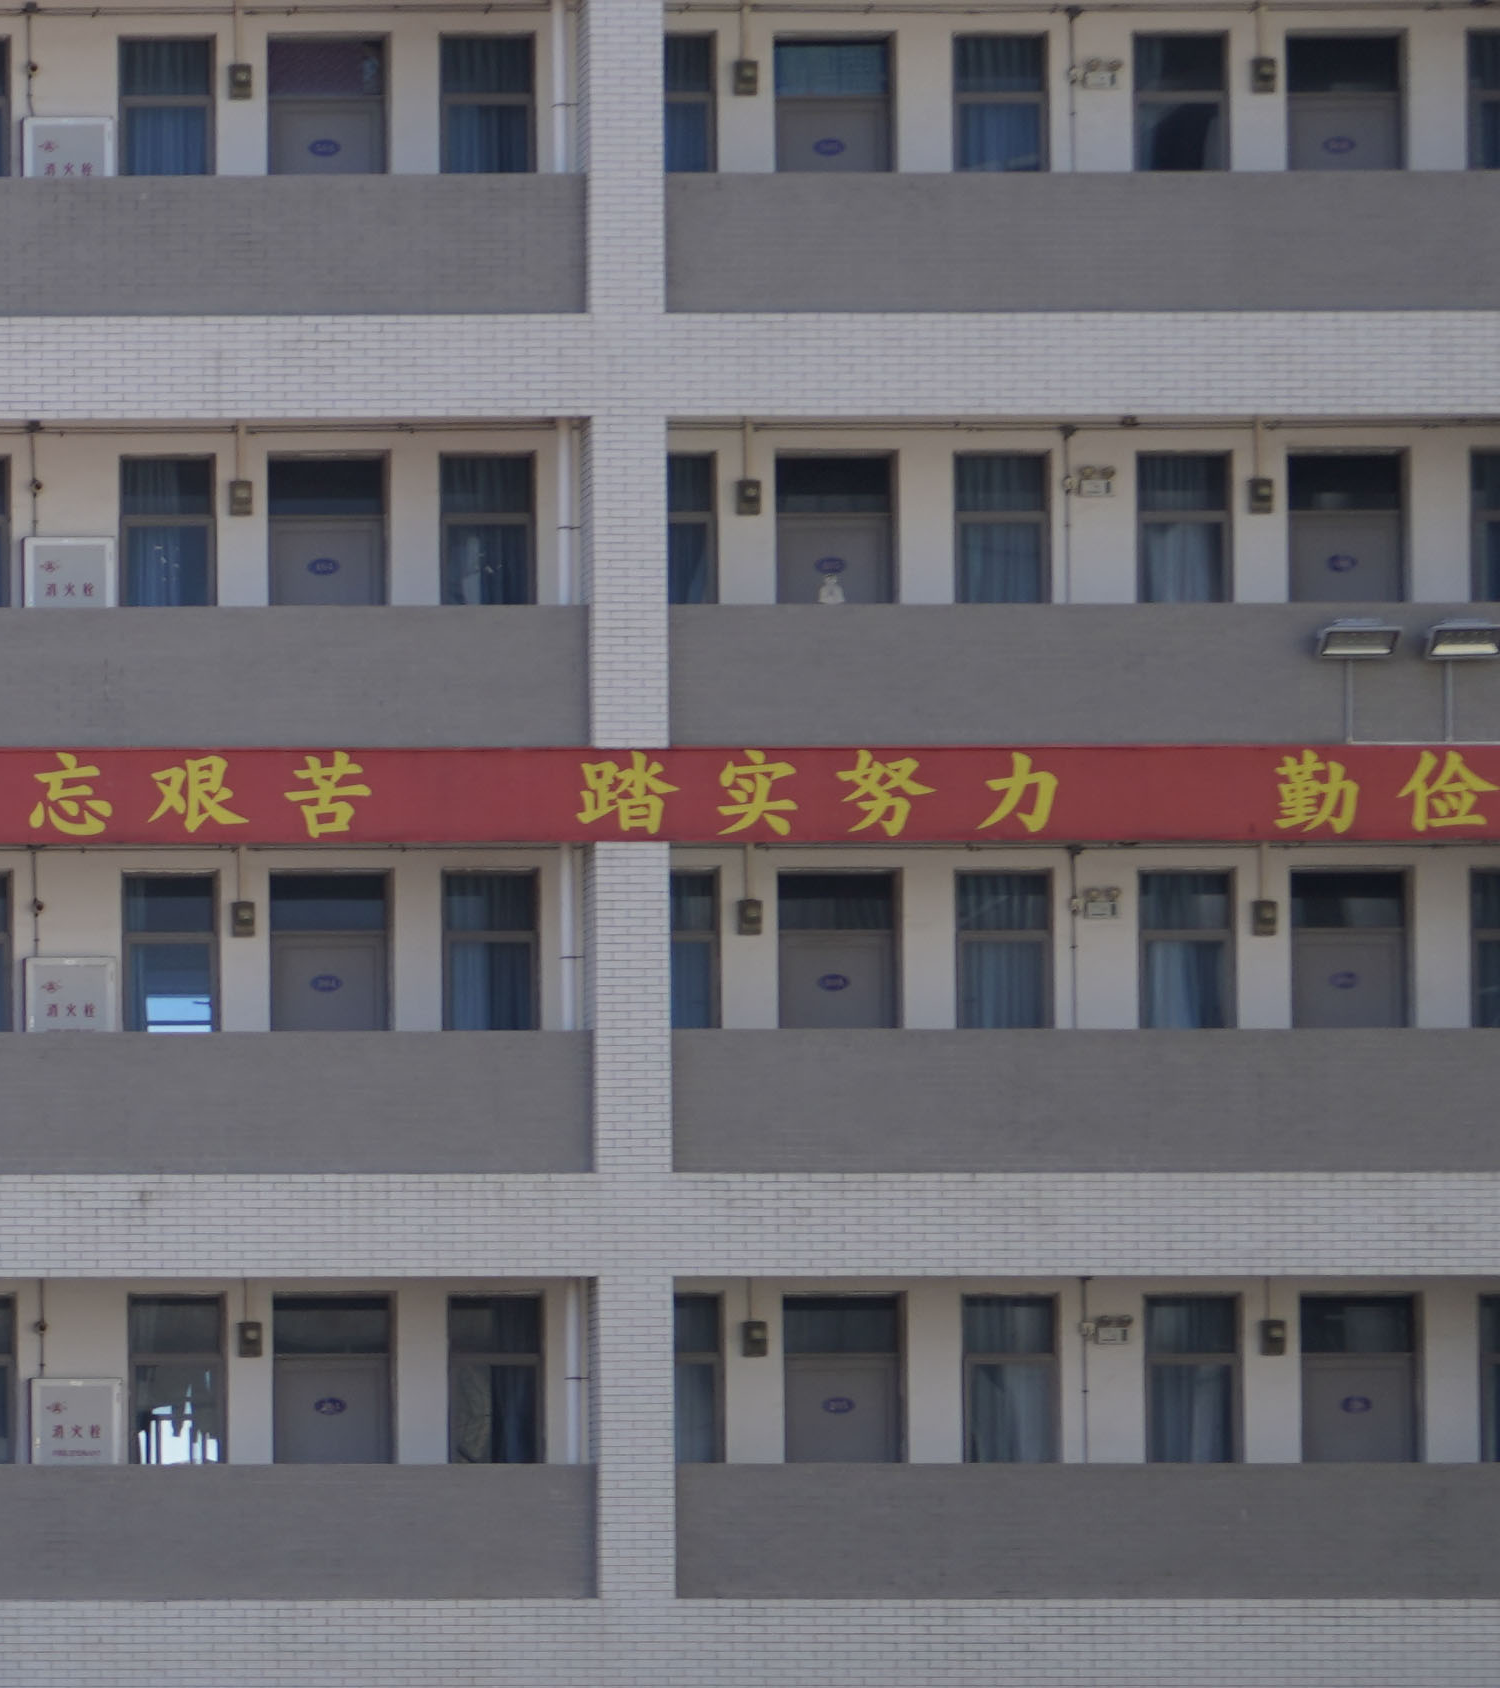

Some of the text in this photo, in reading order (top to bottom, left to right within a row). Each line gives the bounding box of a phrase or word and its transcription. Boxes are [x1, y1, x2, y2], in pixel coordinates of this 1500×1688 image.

[575, 749, 1059, 837] 踏实努力
[1273, 748, 1500, 834] 勤俭
